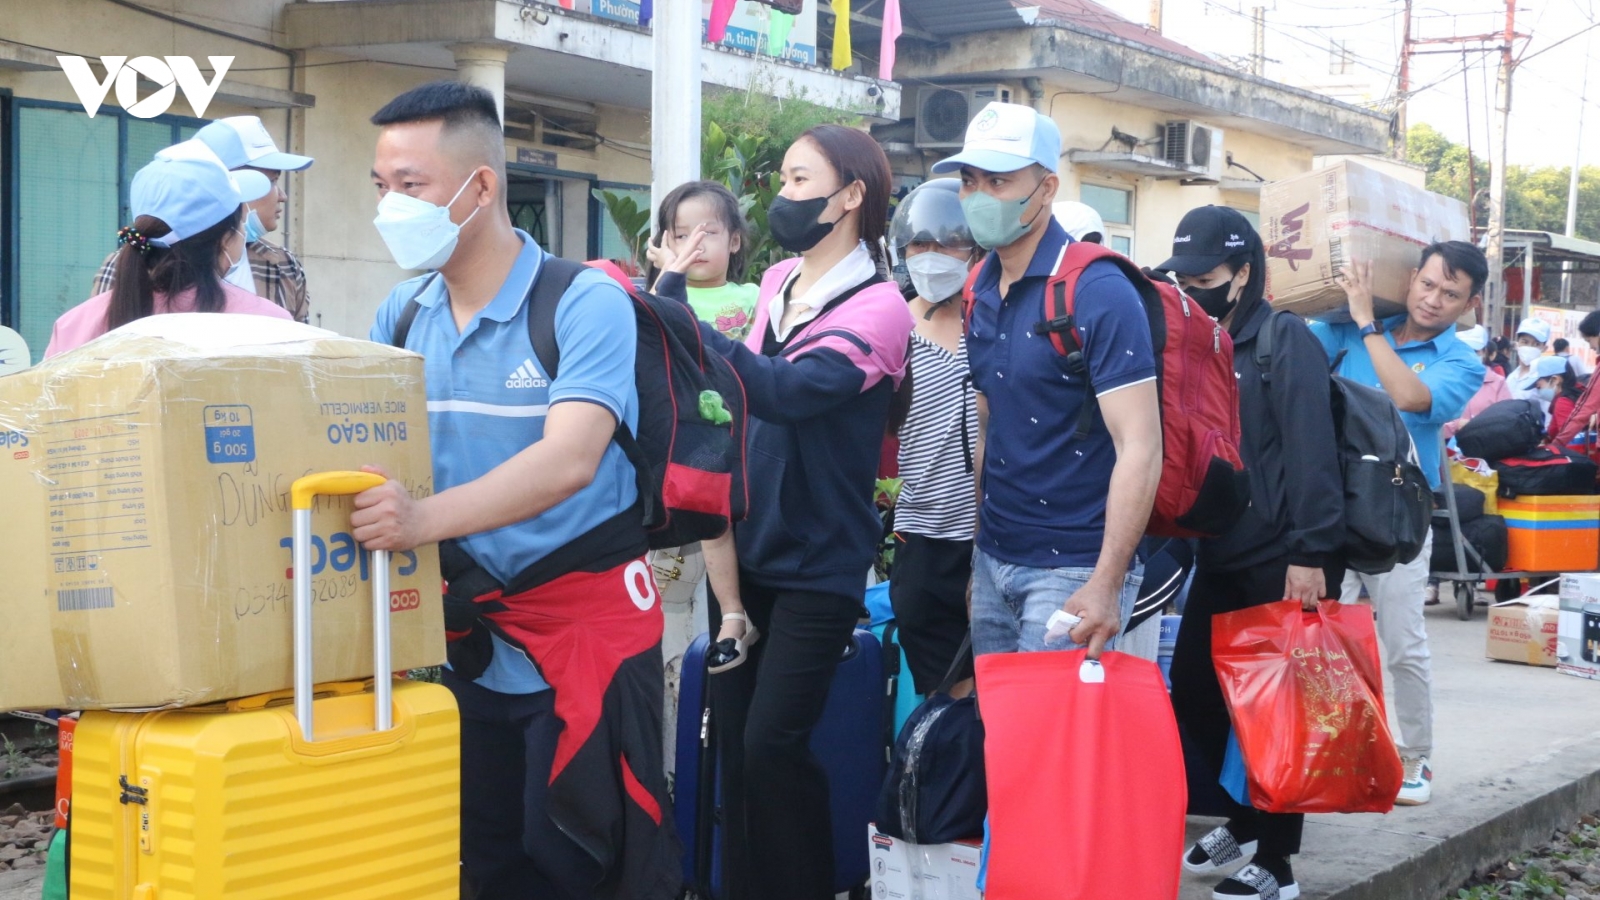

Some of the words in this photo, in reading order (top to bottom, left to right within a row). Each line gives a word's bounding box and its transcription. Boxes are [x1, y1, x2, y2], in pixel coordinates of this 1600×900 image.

[505, 377, 548, 389] adidas
[320, 401, 383, 416] VERMICELLI
[384, 401, 406, 413] RICE
[214, 410, 227, 421] kg
[229, 412, 240, 422] 10
[232, 429, 241, 437] 20
[327, 418, 369, 445] GẠO
[374, 421, 408, 446] BÚN
[213, 442, 222, 454] g
[225, 443, 247, 456] 500
